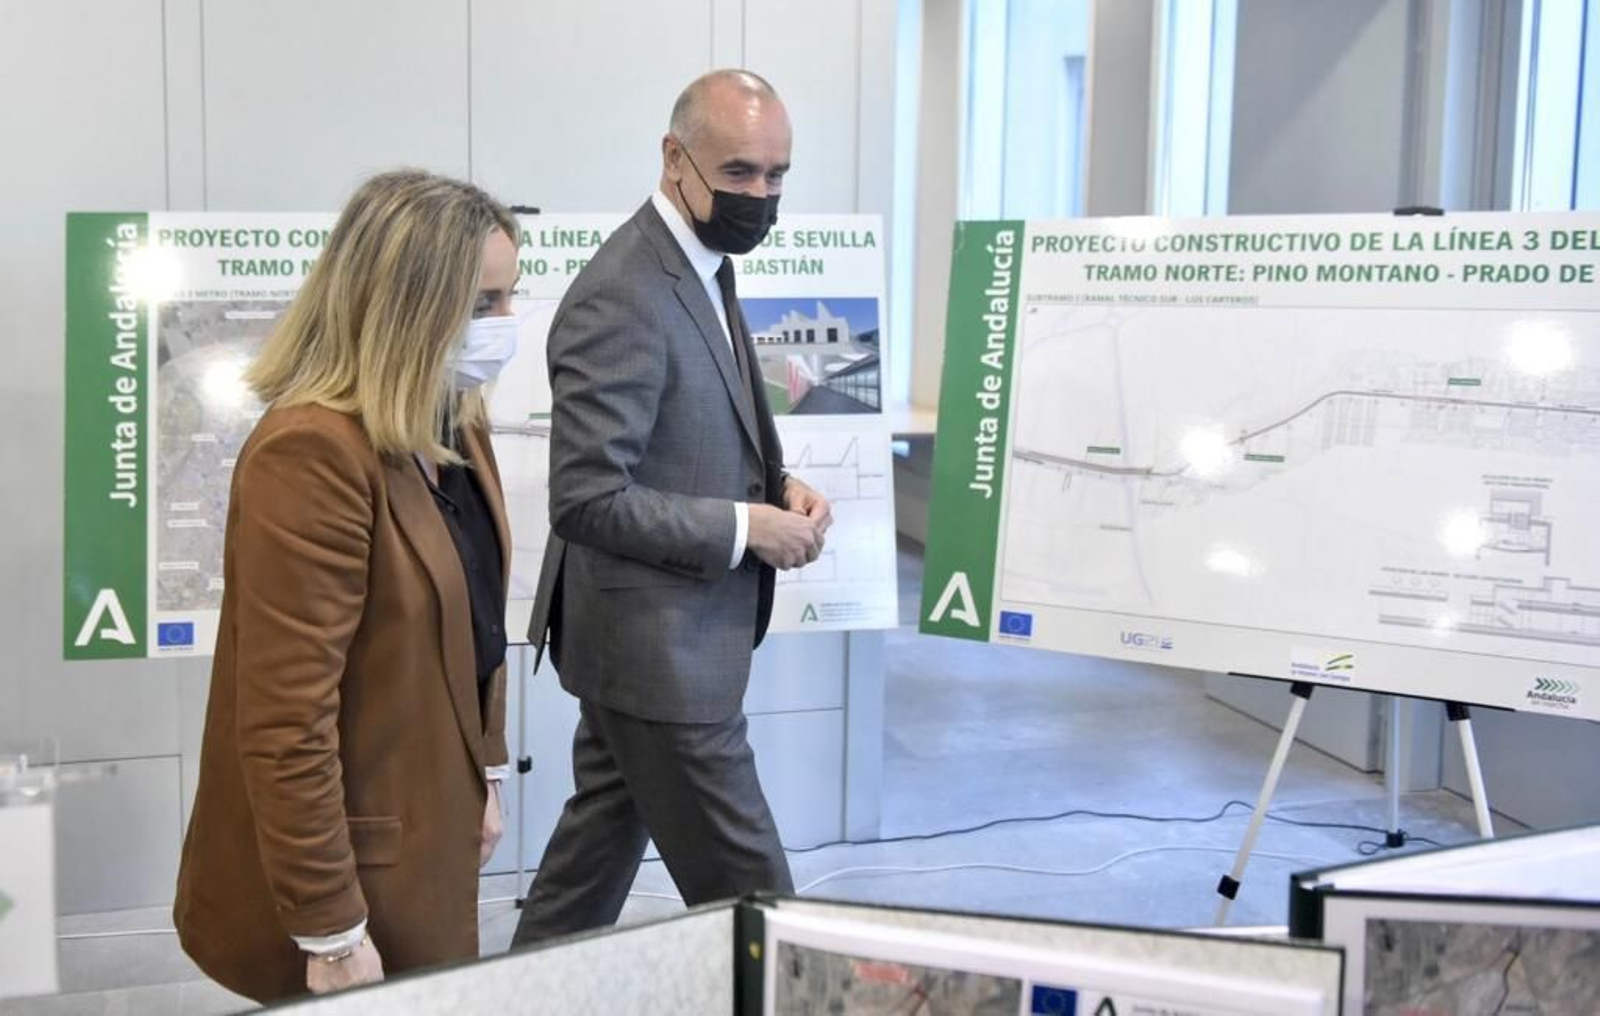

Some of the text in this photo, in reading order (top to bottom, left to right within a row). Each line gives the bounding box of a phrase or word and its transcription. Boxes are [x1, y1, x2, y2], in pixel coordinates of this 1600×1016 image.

[158, 229, 280, 248] PROYECTO
[288, 229, 329, 248] CON
[521, 230, 533, 248] A
[540, 226, 602, 248] LÍNEA
[793, 230, 876, 248] SEVILLA
[1031, 226, 1600, 253] PROYECTO CONSTRUCTIVO DE LA LÍNEA 3 DEL
[217, 259, 294, 276] TRAMO
[302, 259, 315, 276] N
[519, 259, 548, 276] NO
[742, 254, 824, 275] BASTIÁN
[1084, 264, 1158, 282] TRAMO
[1164, 264, 1245, 282] NORTE:
[1252, 264, 1309, 282] PINO
[1316, 264, 1440, 283] MONTANO
[1462, 264, 1550, 283] PRADO
[1559, 264, 1595, 283] DE
[969, 229, 1016, 499] Junta de Andalucía
[108, 376, 137, 414] de
[109, 421, 138, 508] Junta
